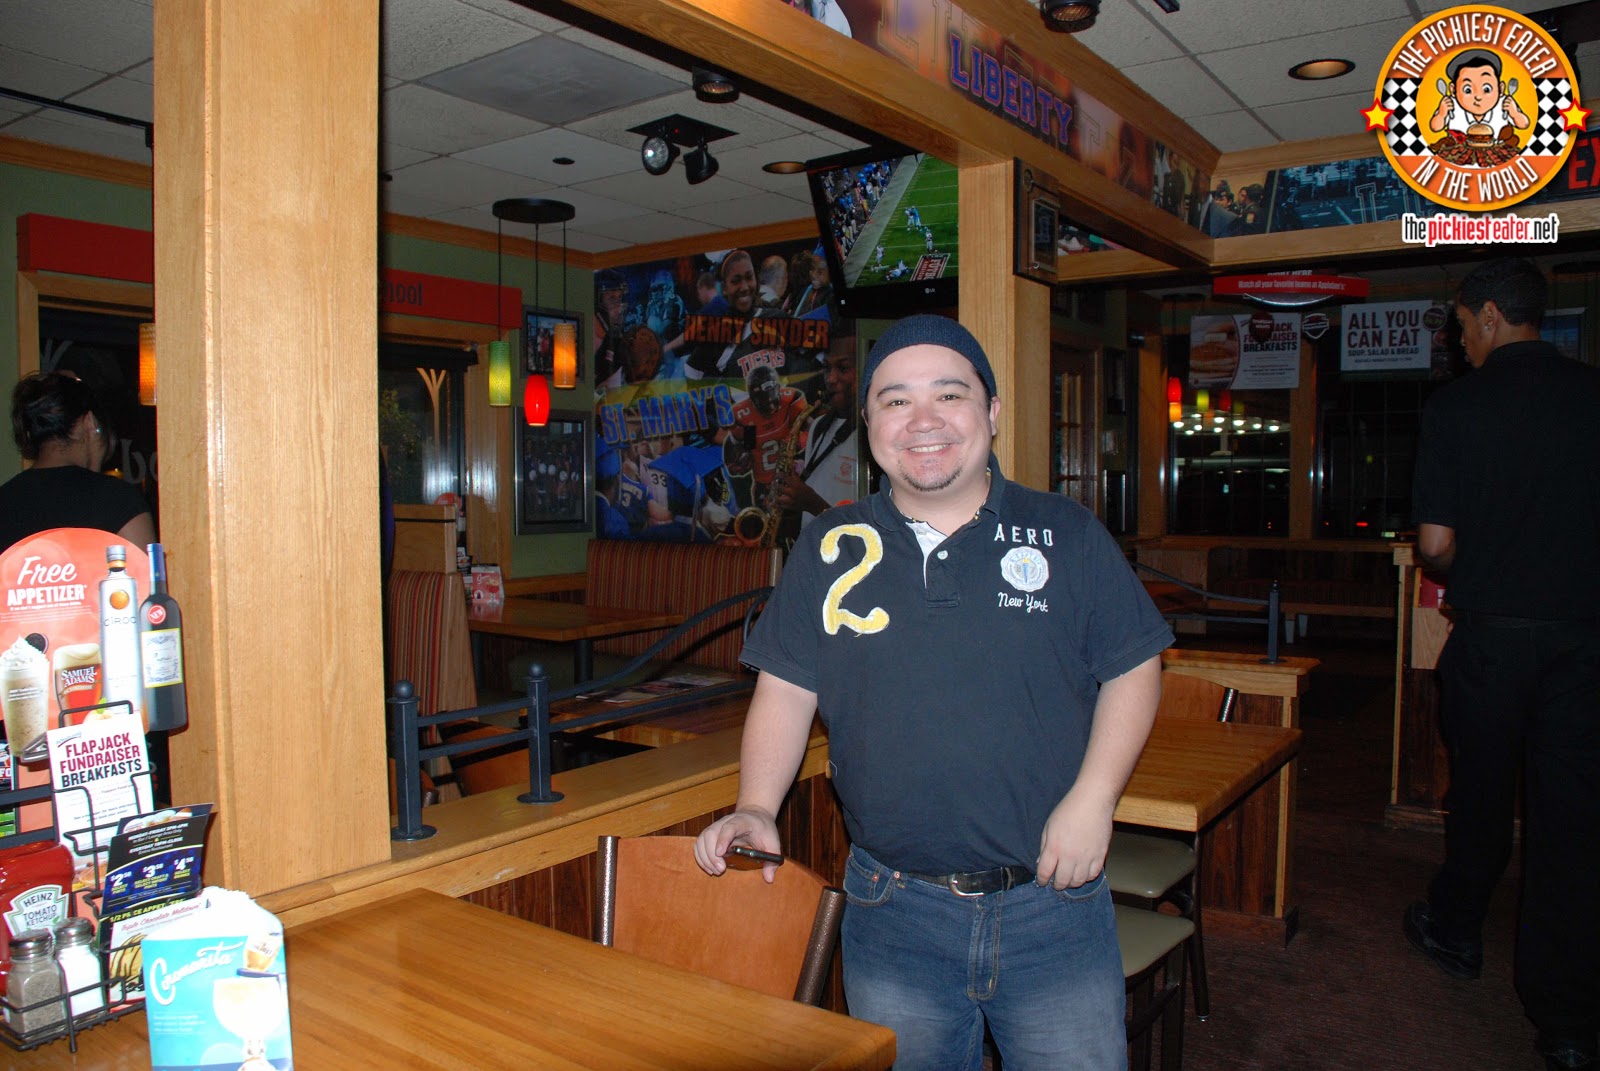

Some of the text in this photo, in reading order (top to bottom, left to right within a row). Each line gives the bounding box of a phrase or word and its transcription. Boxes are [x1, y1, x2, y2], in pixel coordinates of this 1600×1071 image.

[949, 33, 1073, 145] LIBERTY
[1348, 312, 1380, 330] ALL
[1386, 310, 1420, 328] YOU
[684, 315, 830, 349] HENRY SNYDER
[1347, 328, 1420, 348] CAN EAT
[1244, 342, 1298, 352] BREAKFASTS
[738, 350, 786, 380] TIGERS
[601, 384, 735, 445] ST. MARY'S
[994, 523, 1053, 547] AERO
[17, 556, 77, 586] Free
[820, 523, 890, 636] 2
[998, 592, 1048, 614] New York
[150, 609, 164, 619] NEW
[61, 666, 98, 680] SAMUEL
[64, 675, 95, 688] ADAMS
[60, 745, 140, 774] FUNDRAISER
[62, 758, 142, 788] BREAKFASTS
[24, 892, 53, 908] HEINZ
[122, 908, 142, 919] PRCE
[143, 899, 185, 913] APPETZERS
[23, 904, 58, 920] TOMATO
[26, 912, 57, 926] KETCHUP
